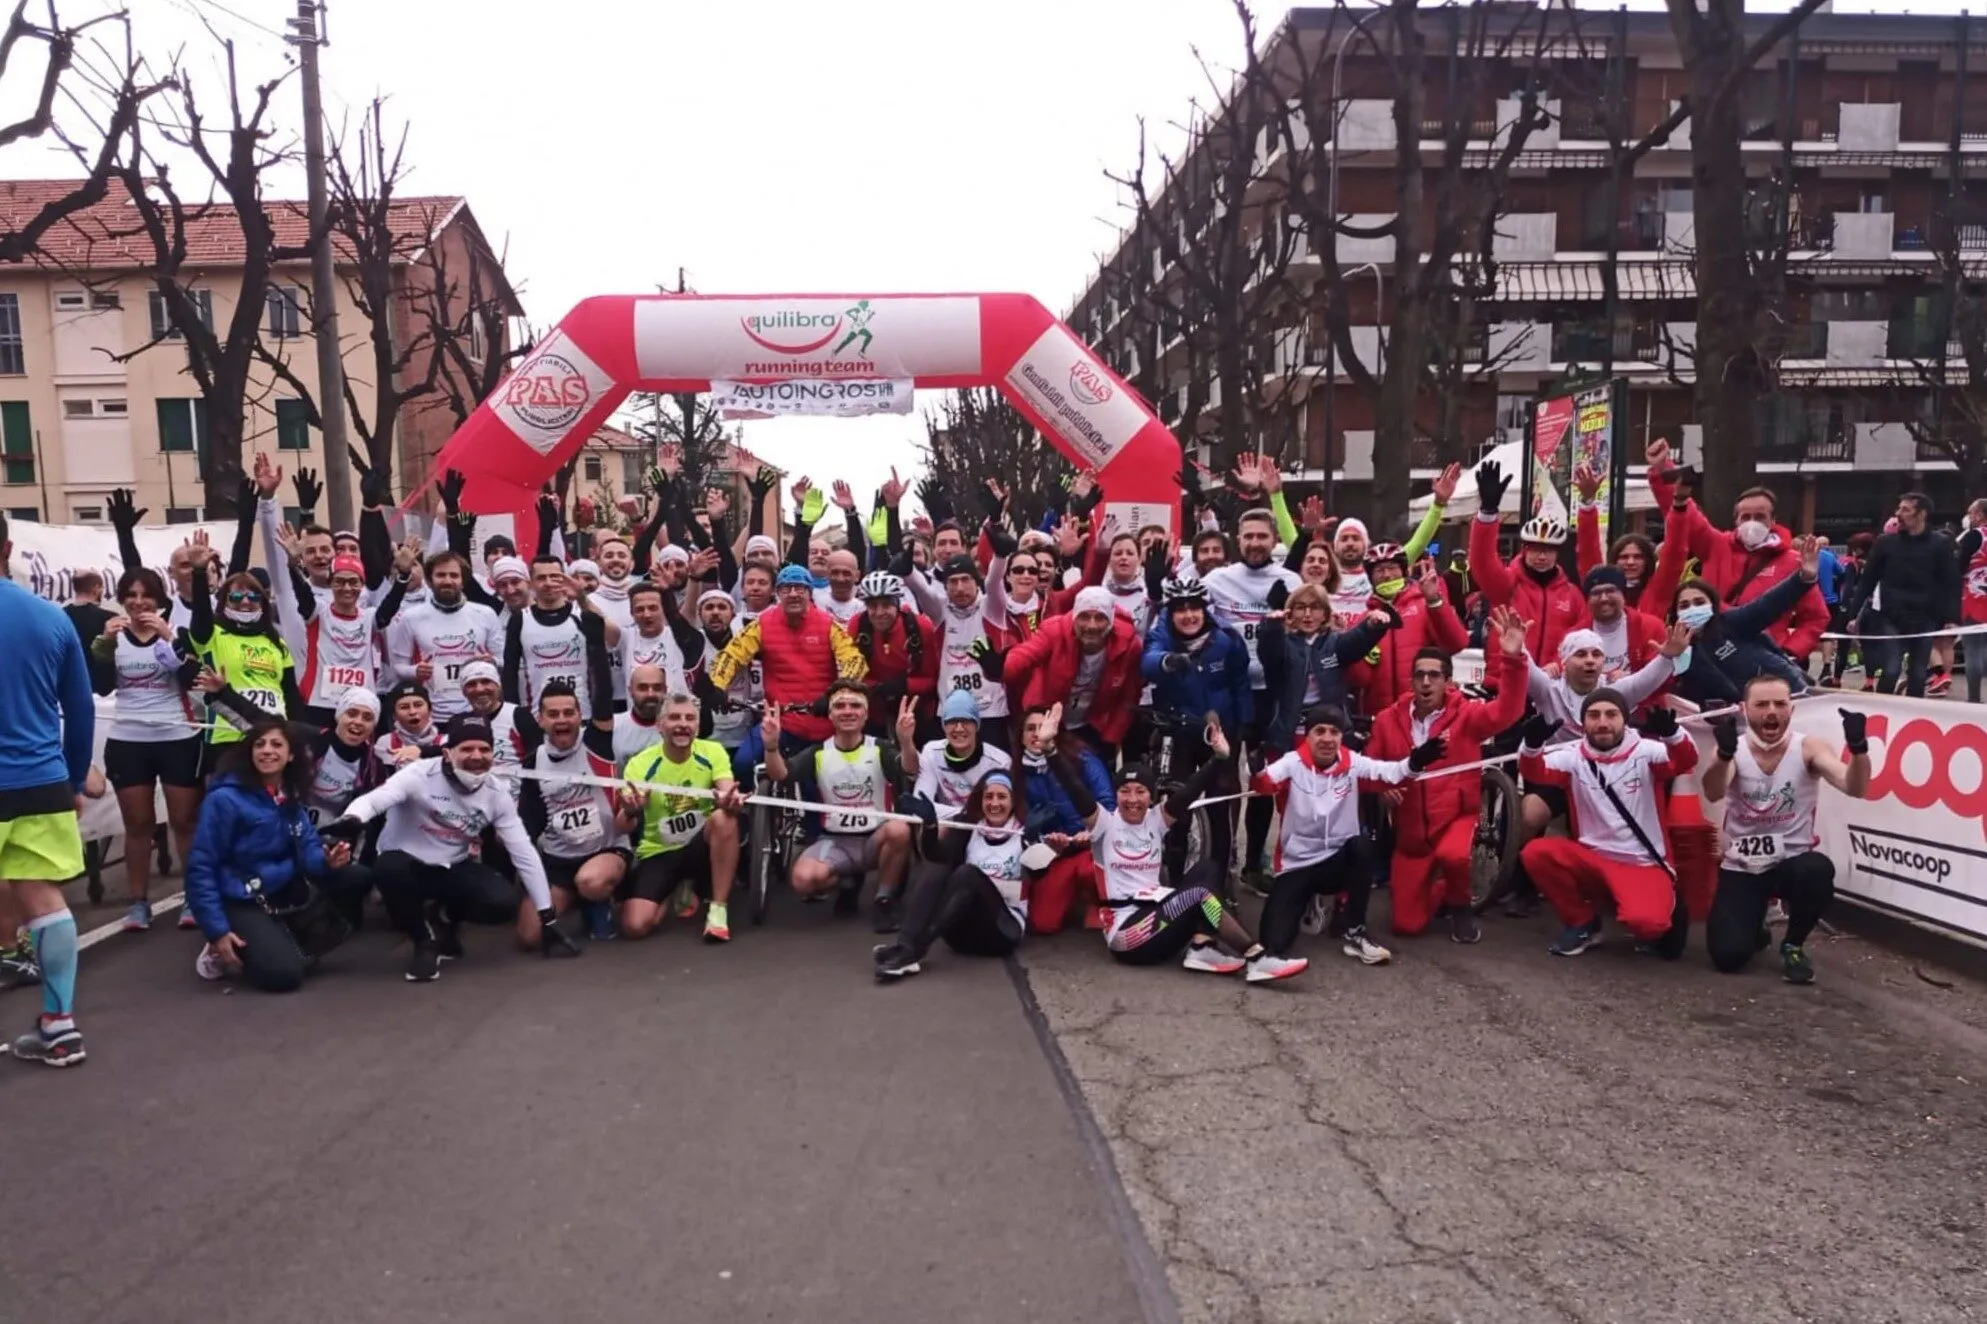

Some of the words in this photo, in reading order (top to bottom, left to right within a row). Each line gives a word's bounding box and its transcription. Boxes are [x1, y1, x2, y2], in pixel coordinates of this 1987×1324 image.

[506, 375, 589, 406] PAS
[1071, 360, 1113, 402] PAS
[329, 667, 364, 687] 1129
[953, 672, 982, 691] 388
[249, 689, 276, 708] 279
[561, 807, 590, 830] 212
[666, 811, 697, 834] 100
[1738, 835, 1775, 856] 428
[1850, 832, 1951, 883] Novacoop
